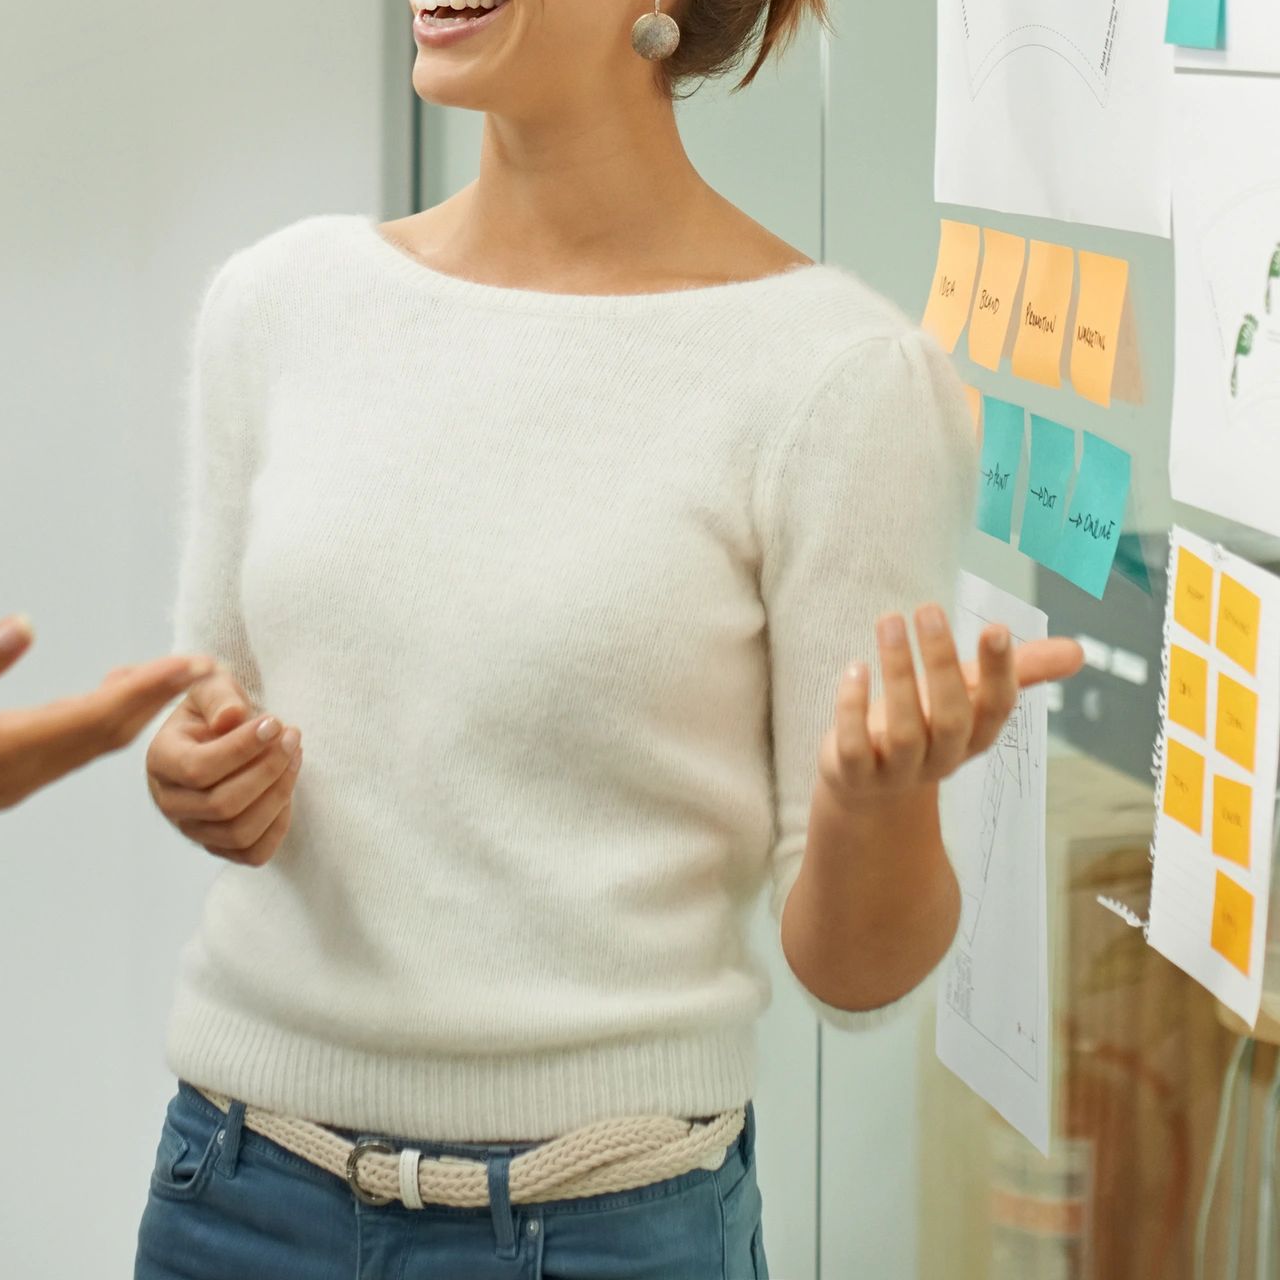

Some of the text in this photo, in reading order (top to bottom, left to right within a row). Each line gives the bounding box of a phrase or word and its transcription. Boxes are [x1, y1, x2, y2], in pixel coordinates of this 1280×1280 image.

[940, 276, 956, 297] IDEA
[1025, 302, 1057, 334] PROMOTION
[1083, 513, 1116, 541] ONLINE
